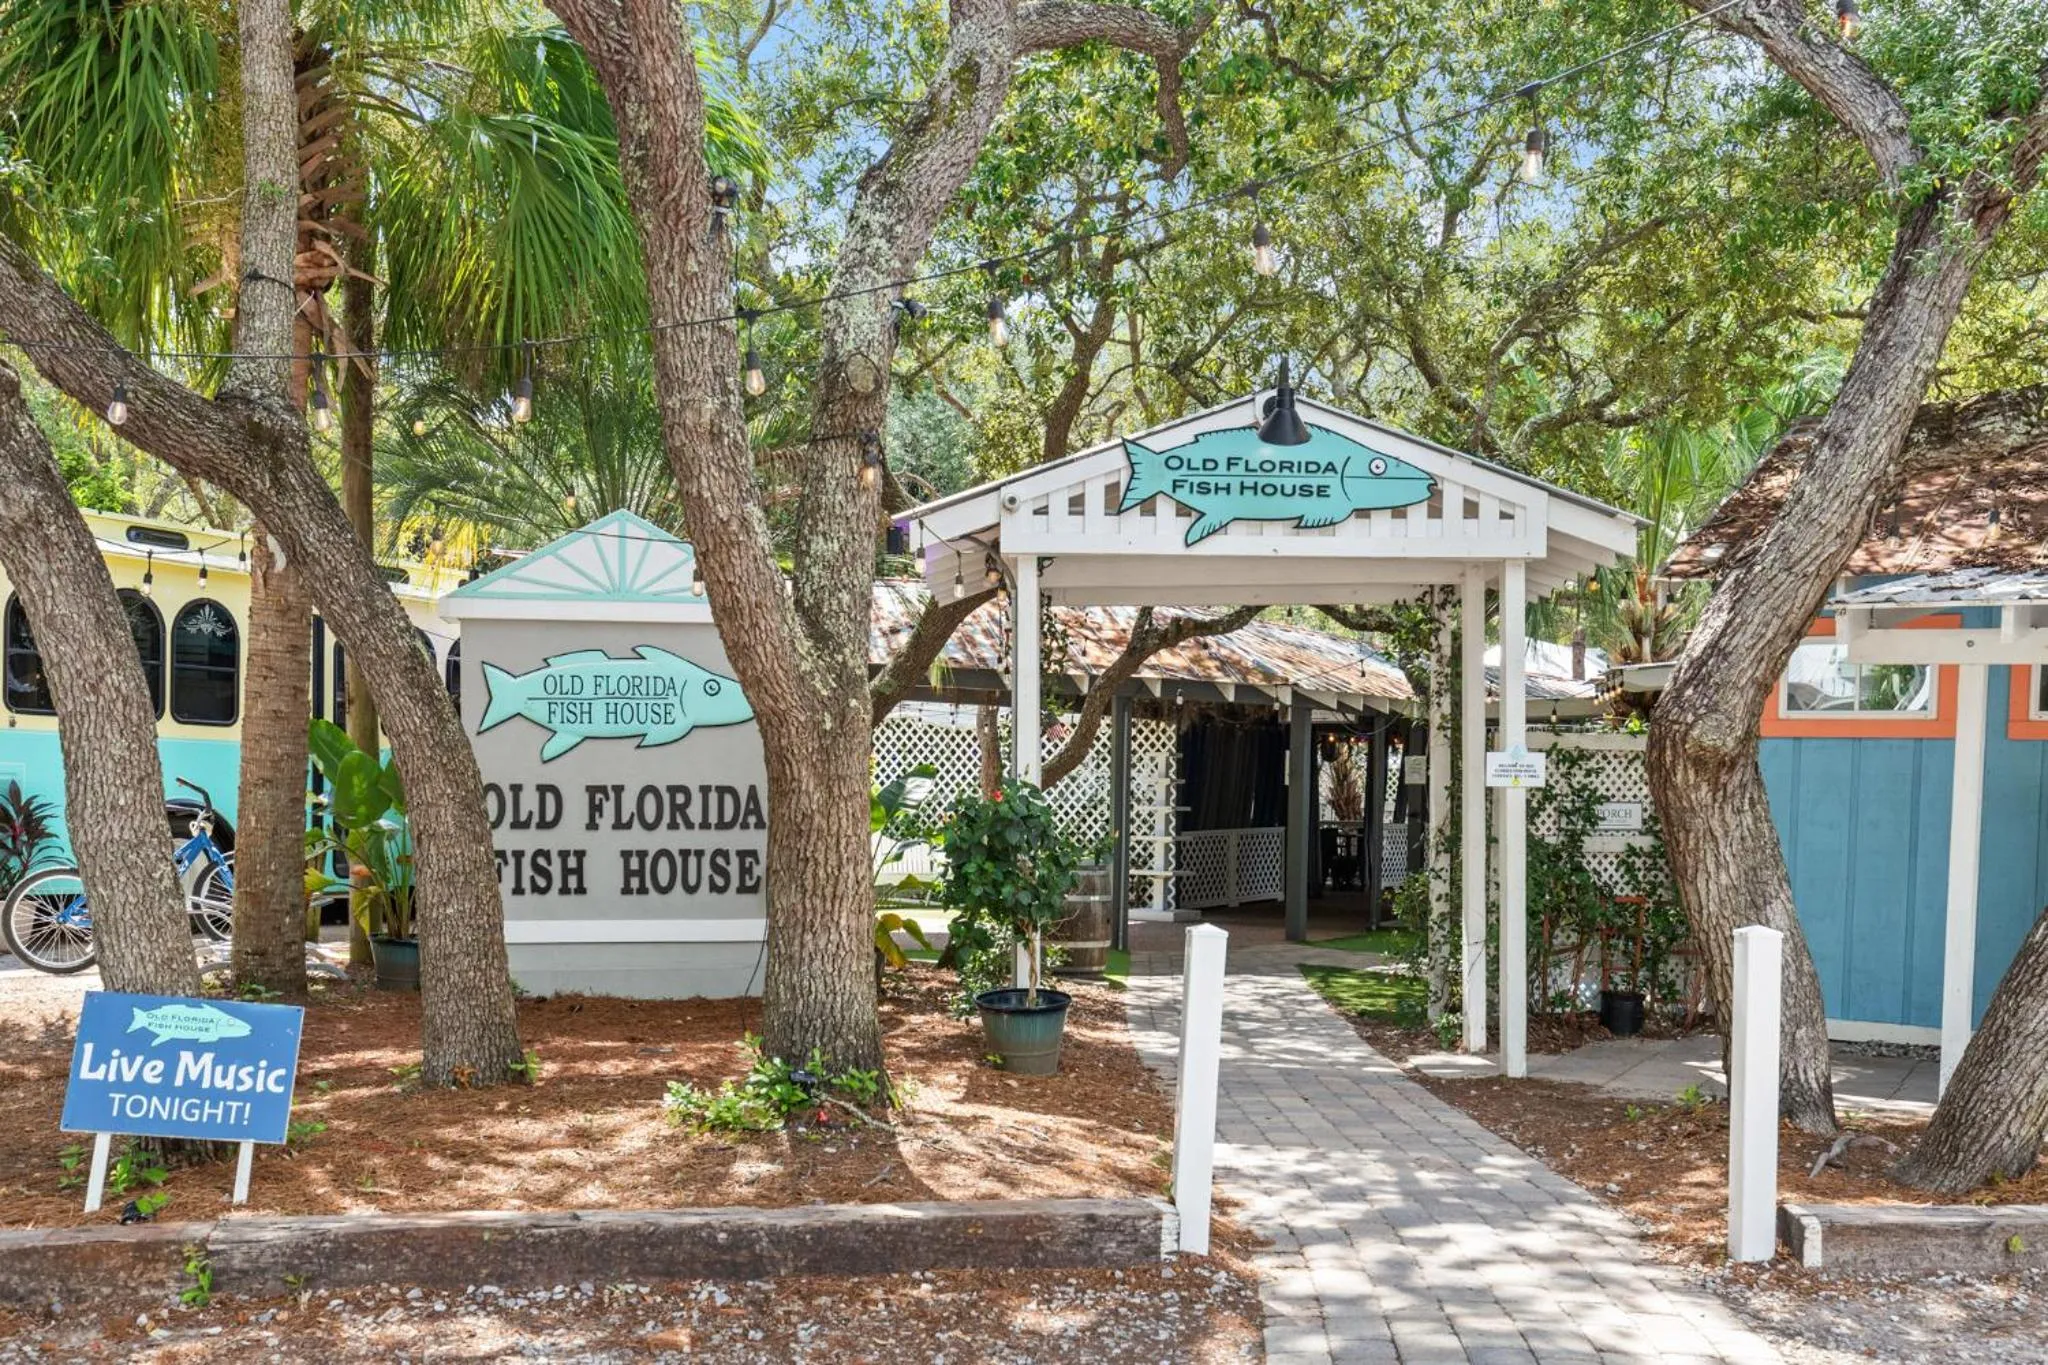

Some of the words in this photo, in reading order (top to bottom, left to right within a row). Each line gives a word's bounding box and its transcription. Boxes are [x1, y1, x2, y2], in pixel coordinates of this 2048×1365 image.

[543, 674, 584, 696] OLD
[593, 675, 678, 697] FLORIDA
[547, 702, 593, 724] FISH
[605, 702, 676, 725] HOUSE
[483, 782, 563, 830] OLD
[585, 784, 766, 831] FLORIDA
[620, 849, 761, 895] HOUSE
[146, 1012, 168, 1021] OLD
[171, 1014, 215, 1024] FLORIDA
[148, 1021, 172, 1029] FISH
[174, 1023, 210, 1033] HOUSE
[79, 1042, 164, 1084] Live
[174, 1050, 286, 1093] Music
[108, 1092, 251, 1126] TONIGHT!
